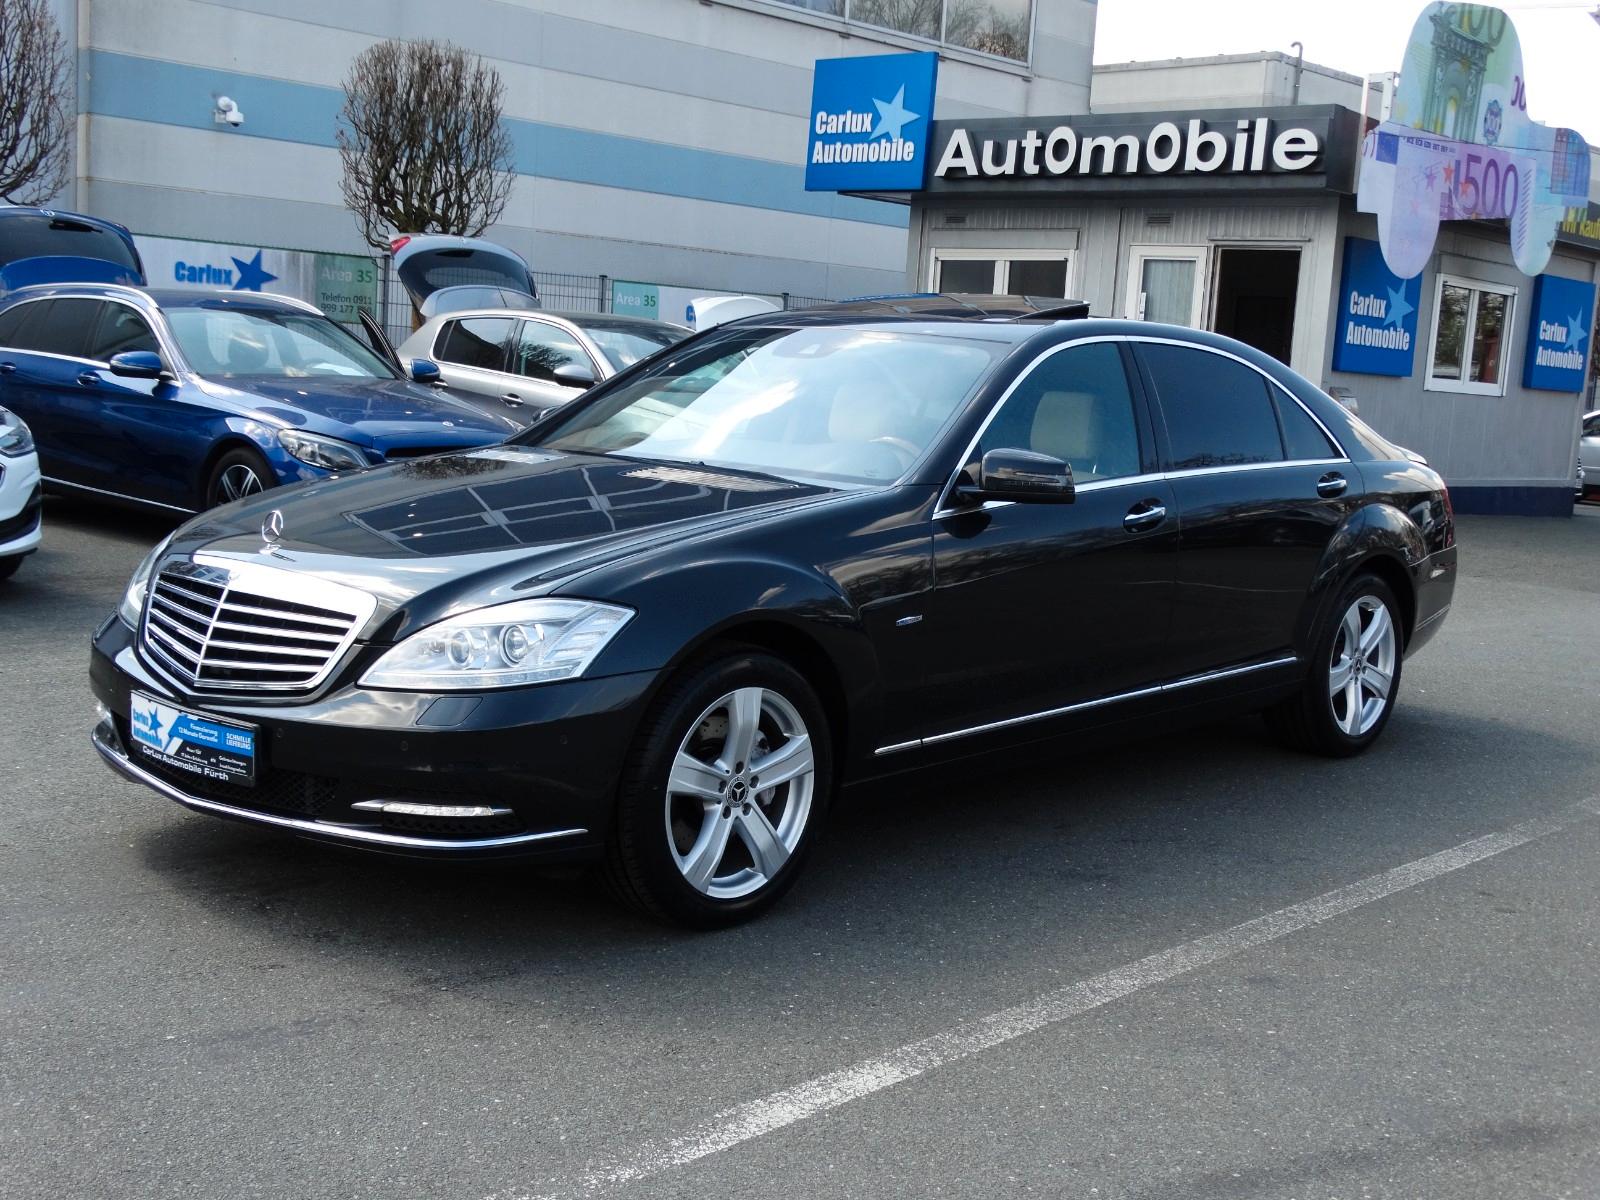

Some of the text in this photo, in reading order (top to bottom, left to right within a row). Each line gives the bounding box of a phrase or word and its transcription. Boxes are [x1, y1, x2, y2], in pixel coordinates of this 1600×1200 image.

[815, 109, 873, 135] Carlux
[811, 136, 915, 165] Automobile
[174, 260, 233, 286] Carlux
[321, 266, 373, 284] Area 35
[321, 292, 373, 306] Telefon 0911
[615, 292, 656, 308] Area 35
[1349, 290, 1387, 319] Carlux
[685, 305, 697, 322] C
[1345, 320, 1411, 351] Automobile
[1539, 319, 1568, 344] Carlux
[1535, 346, 1584, 371] Automobile
[226, 732, 251, 744] SCHNELLE
[162, 753, 202, 774] Automobile
[203, 767, 229, 781] Fürth
